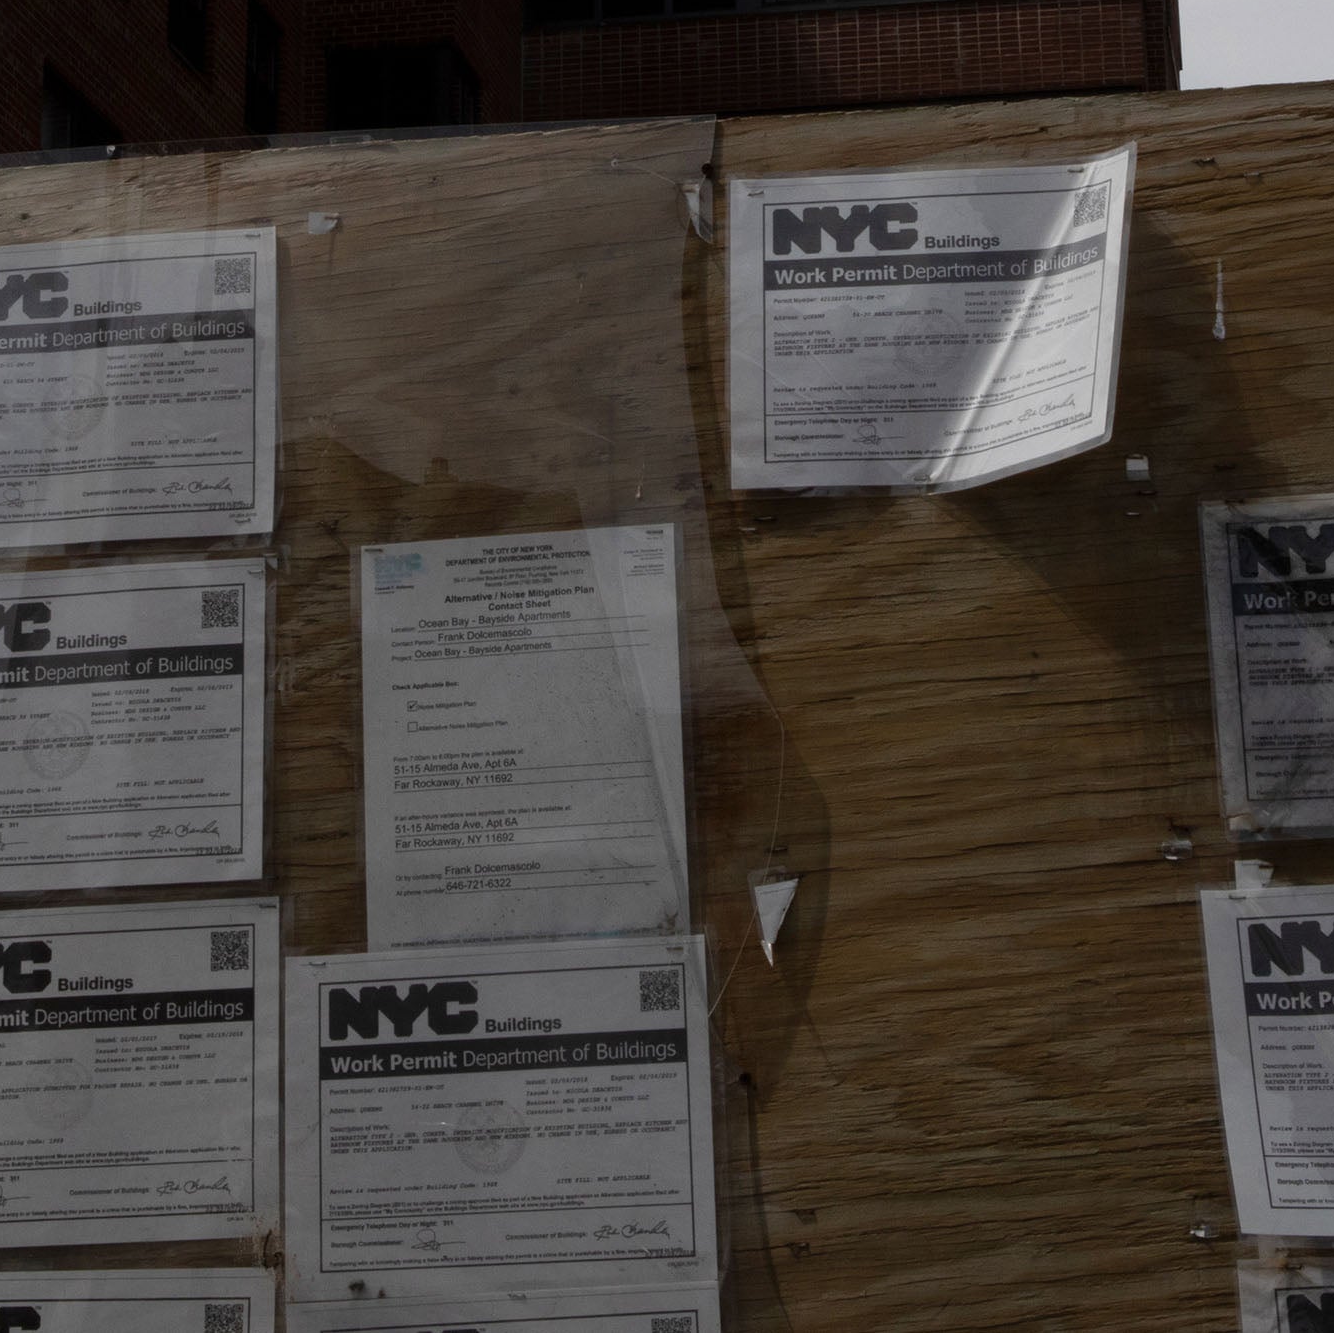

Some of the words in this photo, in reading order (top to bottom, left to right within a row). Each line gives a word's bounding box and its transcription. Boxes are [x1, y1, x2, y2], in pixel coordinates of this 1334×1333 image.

[446, 559, 487, 567] DEPARTMENT
[499, 555, 549, 563] ENVIRONMENTAL
[551, 551, 590, 560] PROTECTION
[483, 548, 495, 556] THE
[498, 547, 509, 555] CITY
[536, 545, 553, 553] YORK
[445, 593, 493, 604] Alternative
[500, 591, 525, 600] Noise
[528, 588, 573, 601] Mitigation
[575, 586, 594, 595] Plan
[488, 602, 521, 612] Contact
[525, 600, 550, 609] Sheet
[418, 618, 449, 629] Ocean
[451, 617, 469, 628] Bay
[478, 614, 515, 626] Bayside
[518, 610, 571, 622] Apartments
[57, 634, 126, 648] Buildings
[438, 630, 464, 642] Frank
[467, 627, 532, 640] Dolcemascolo
[414, 649, 443, 659] Ocean
[445, 647, 461, 658] Bay
[469, 643, 502, 656] Bayside
[504, 641, 551, 652] Apartments
[35, 660, 130, 683] Department
[136, 657, 152, 673] of
[159, 655, 232, 673] Buildings
[413, 682, 444, 690] Applicable
[435, 702, 461, 710] Mitigation
[394, 765, 421, 775] 51-15
[424, 761, 459, 773] Almeda
[461, 760, 482, 772] Ave,
[484, 758, 501, 770] Apt
[503, 757, 517, 767] 6A
[395, 780, 410, 790] Far
[413, 776, 463, 789] Rockaway,
[466, 775, 482, 785] NY
[484, 773, 513, 784] 11692
[395, 824, 421, 834] 51-15
[424, 821, 460, 832] Almeda
[462, 820, 483, 831] Ave,
[486, 818, 502, 829] Apt
[504, 817, 518, 827] 6A
[395, 839, 411, 849] Far
[414, 837, 464, 848] Rockaway,
[467, 834, 482, 844] NY
[485, 832, 514, 843] 11692
[445, 865, 471, 875] Frank
[474, 861, 541, 874] Dolcemascolo
[446, 879, 512, 890] 646-721-6322
[1256, 993, 1312, 1010] Work
[329, 981, 477, 1040] NYC
[485, 1017, 561, 1032] Buildings
[331, 1054, 383, 1072] Work
[390, 1052, 456, 1069] Permit
[463, 1046, 566, 1069] Department
[572, 1043, 589, 1060] of
[597, 1041, 676, 1060] Buildings
